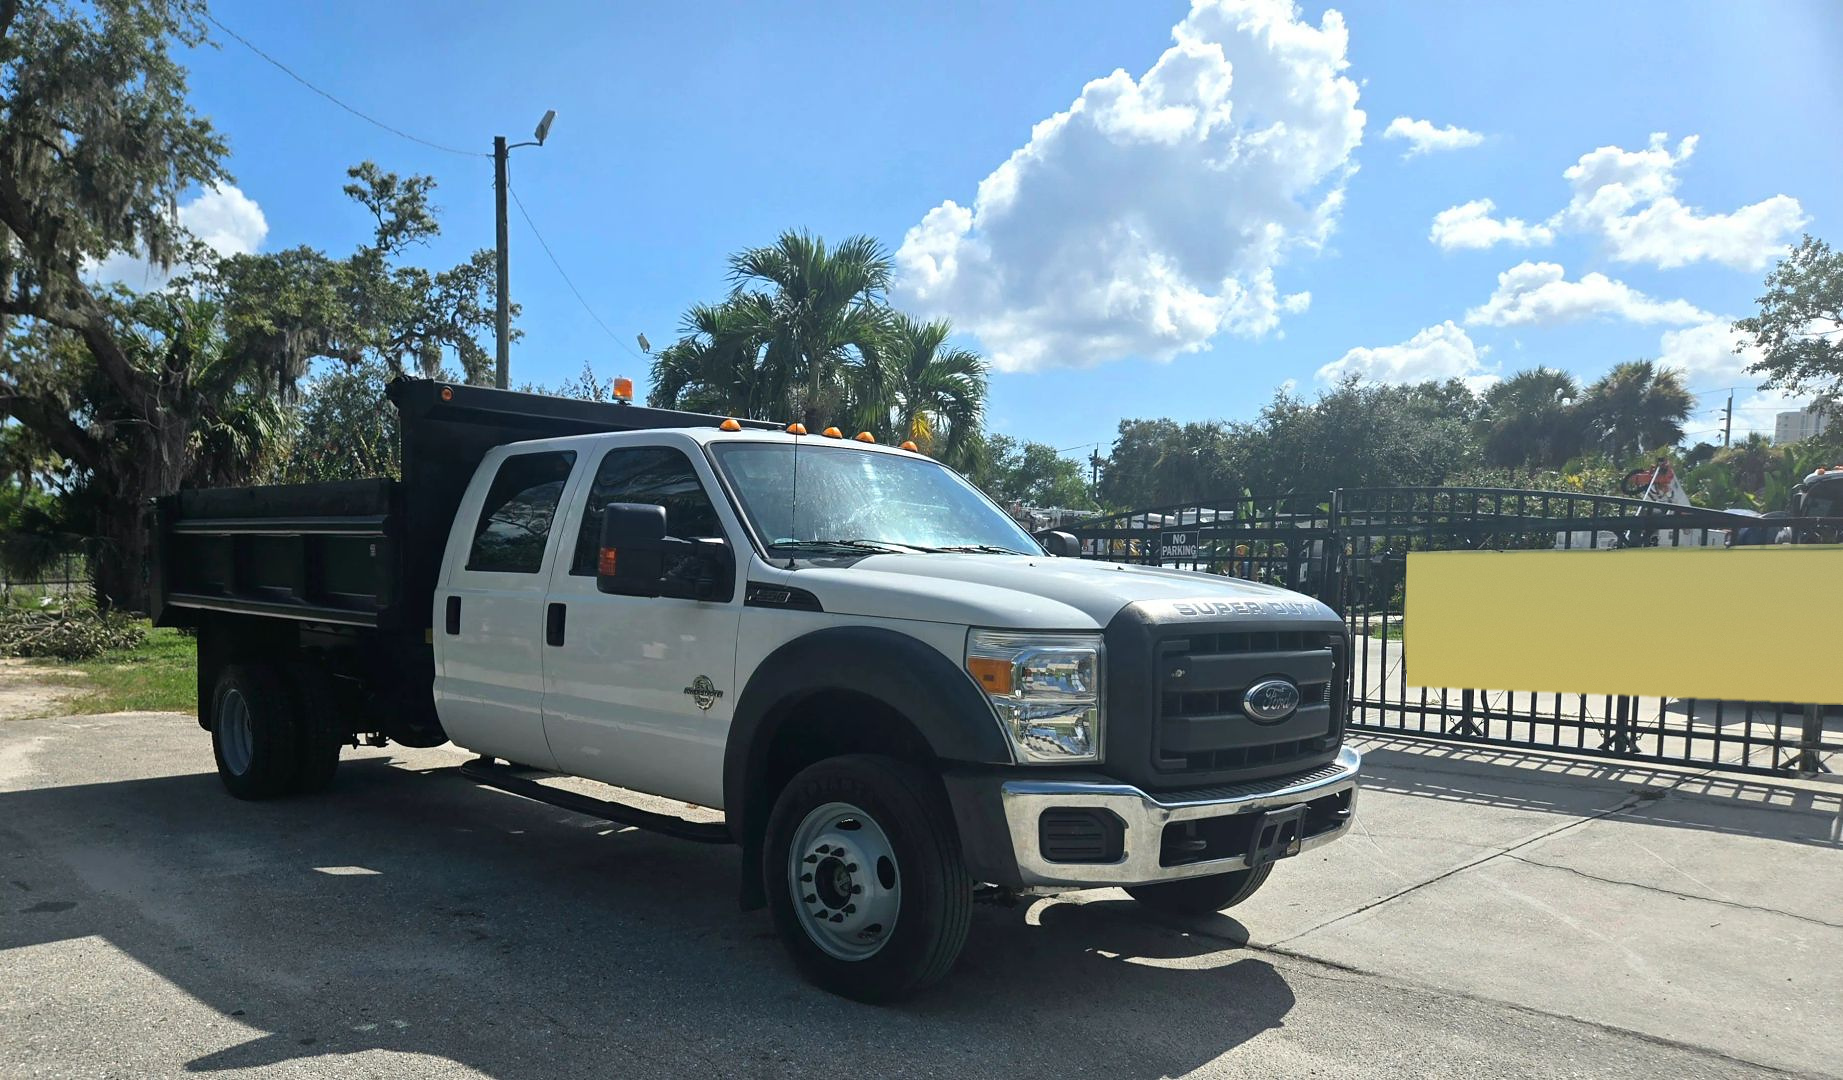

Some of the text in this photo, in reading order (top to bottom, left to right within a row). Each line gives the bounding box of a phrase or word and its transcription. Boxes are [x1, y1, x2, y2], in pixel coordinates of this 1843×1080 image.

[1172, 533, 1187, 545] NO
[1162, 544, 1197, 557] PARKING
[1173, 601, 1321, 616] SUPER DUTY
[1262, 687, 1292, 710] Ford
